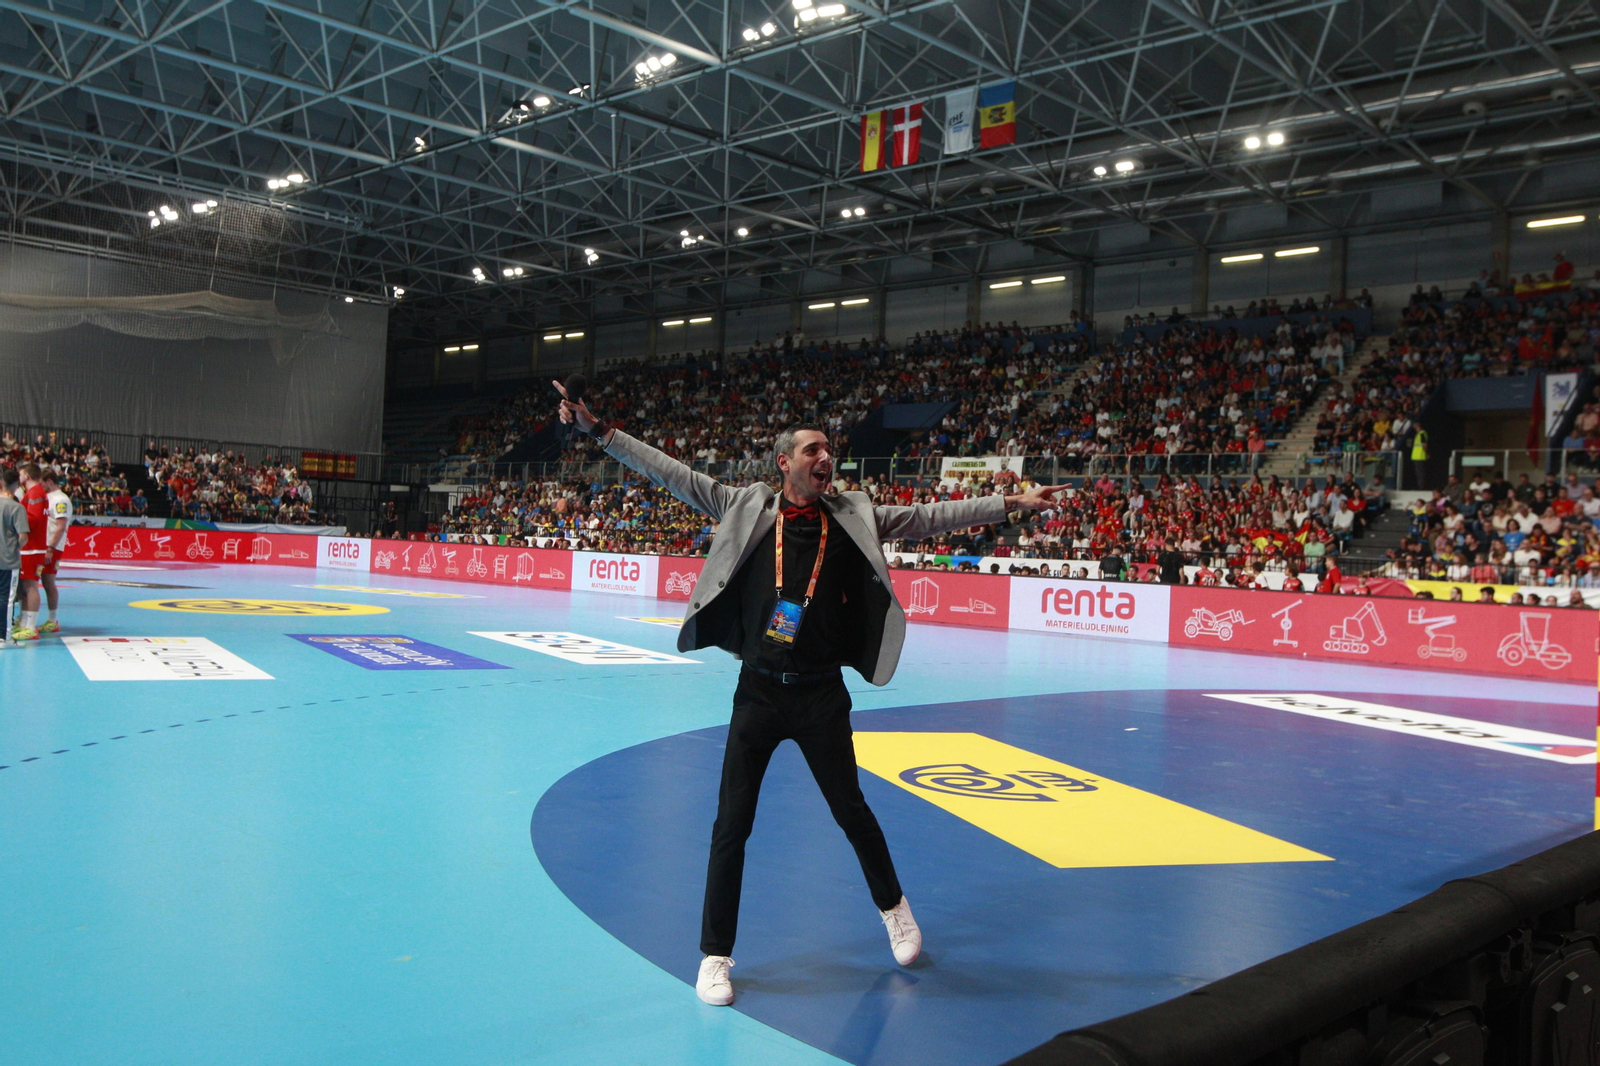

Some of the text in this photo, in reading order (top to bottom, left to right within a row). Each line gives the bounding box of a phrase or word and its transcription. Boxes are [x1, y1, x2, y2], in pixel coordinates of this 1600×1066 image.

[328, 539, 360, 559] renta
[589, 556, 640, 582] renta
[591, 582, 637, 592] MATERIELUDLEJNING
[1041, 585, 1136, 620] renta
[1045, 619, 1130, 634] MATERIELUDLEJNING
